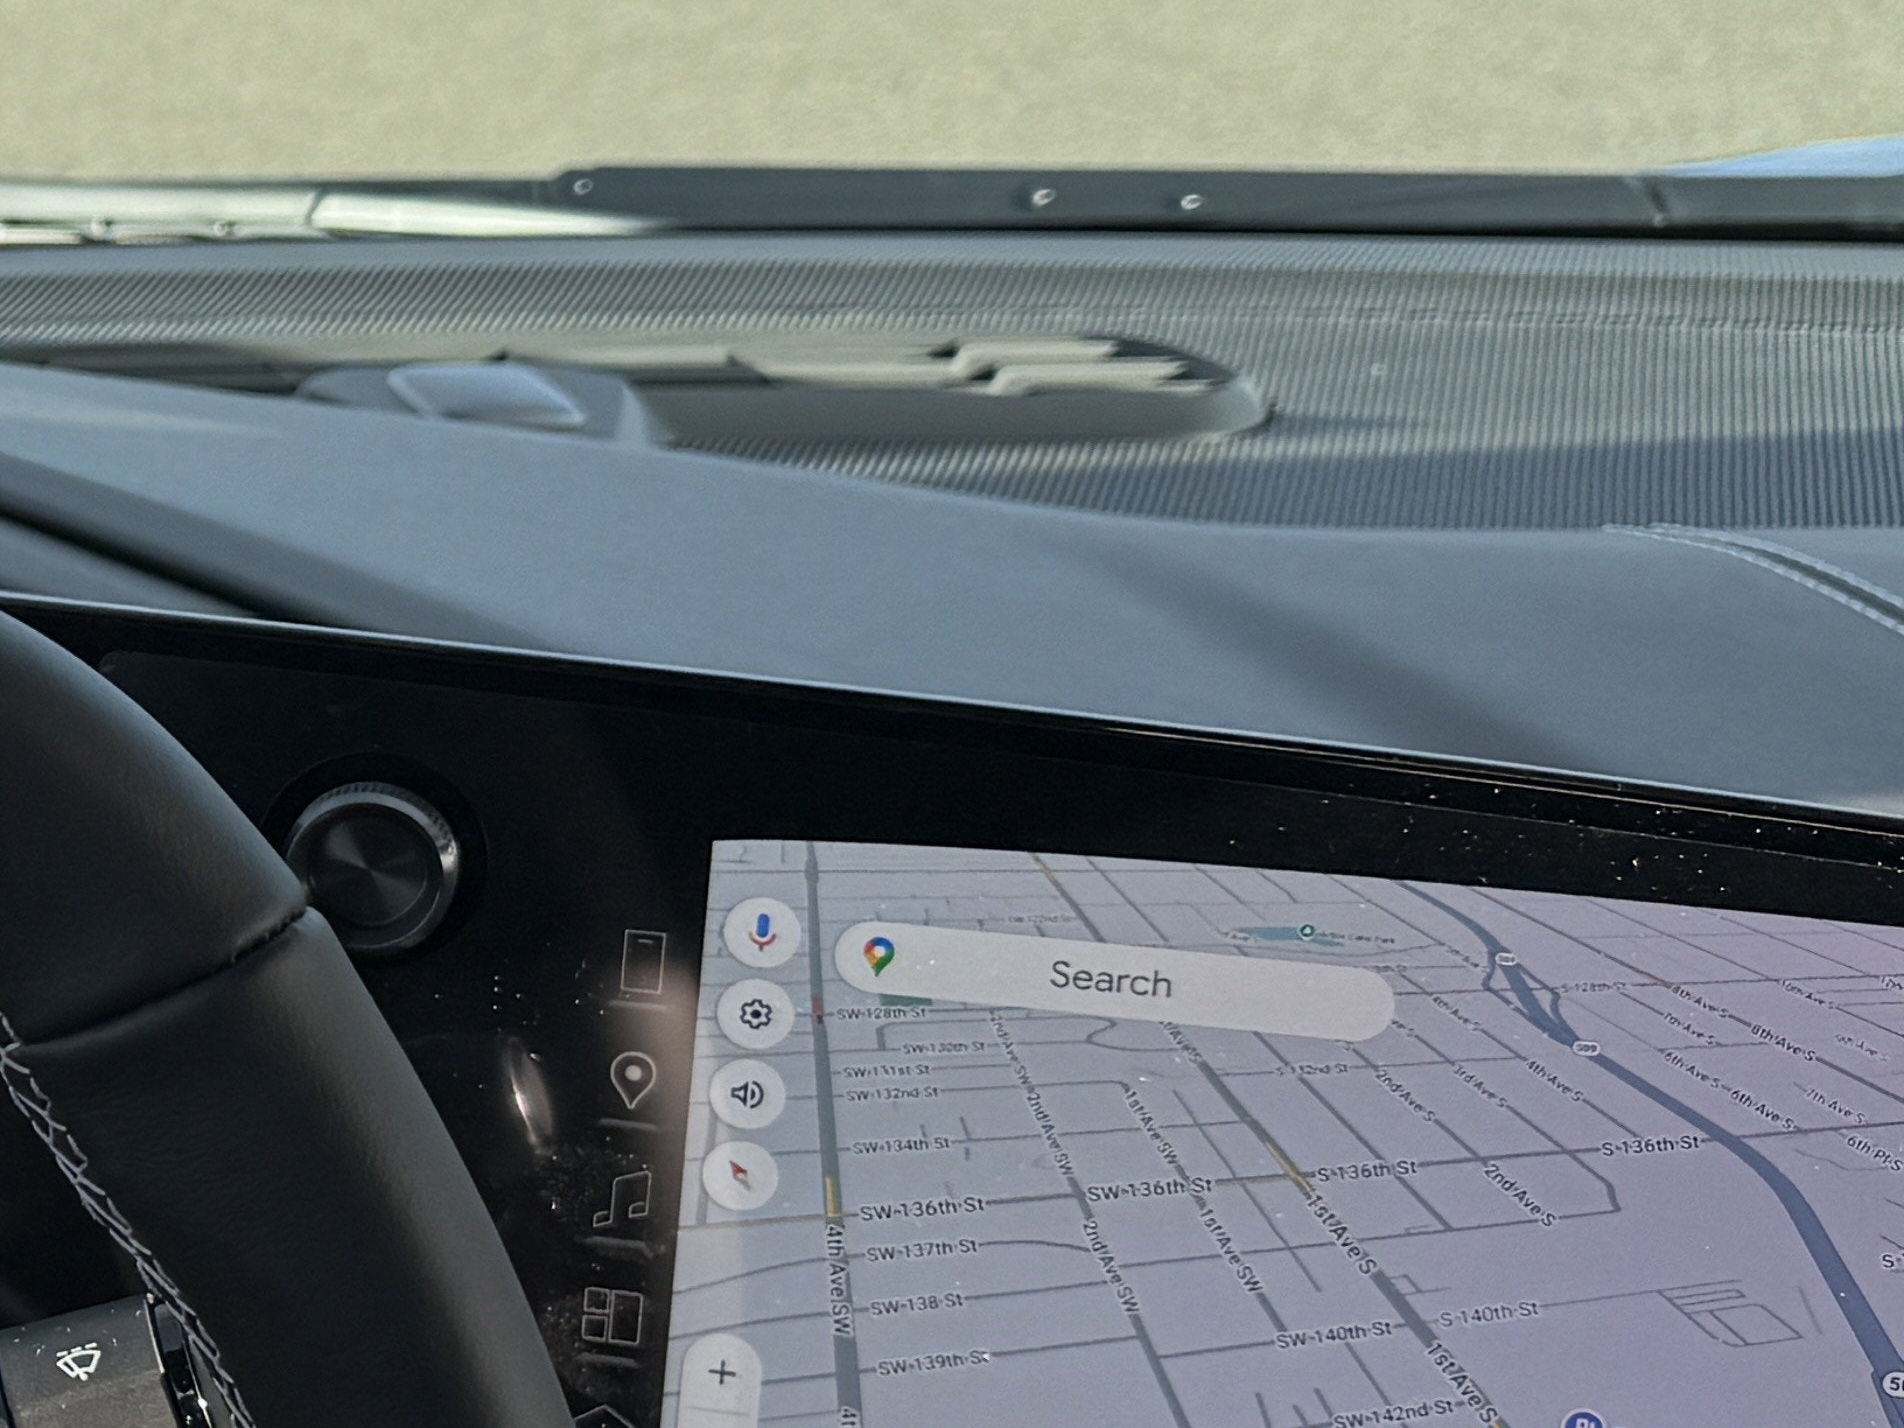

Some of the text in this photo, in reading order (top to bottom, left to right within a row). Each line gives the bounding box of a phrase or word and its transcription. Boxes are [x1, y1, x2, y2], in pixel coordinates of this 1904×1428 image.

[1050, 960, 1172, 998] Search
[1775, 1035, 1802, 1055] Ave
[1804, 1049, 1816, 1061] S
[1548, 1074, 1571, 1093] Ave
[1572, 1091, 1583, 1102] S
[1686, 1064, 1710, 1086] Ave
[1710, 1077, 1721, 1088] S
[1376, 1070, 1435, 1122] 2nd Ave S
[1474, 1081, 1496, 1099] Ave
[1497, 1097, 1507, 1108] S
[1730, 1089, 1795, 1129] 6th Ave S
[1602, 1136, 1700, 1157] S 136th St
[1848, 1136, 1871, 1154] 6th
[1317, 1161, 1416, 1182] S 136th St
[1087, 1178, 1212, 1201] SW 136th St
[1484, 1164, 1556, 1227] 2nd Ave S
[860, 1197, 984, 1221] SW 136th St
[1308, 1194, 1377, 1275] 1st Ave S
[867, 1239, 978, 1262] SW 137th St
[1084, 1222, 1140, 1314] 2nd Ave SW
[1218, 1236, 1241, 1265] Ave
[1237, 1266, 1262, 1292] SW
[827, 1224, 850, 1335] 4th Ave SW
[871, 1293, 963, 1316] SW 138 St
[1441, 1302, 1538, 1327] S 140th St
[1276, 1322, 1392, 1349] SW 140th St
[879, 1361, 907, 1376] SW
[917, 1353, 962, 1371] 139th
[1427, 1343, 1498, 1423] 1st Ave S
[1372, 1404, 1428, 1424] 142nd
[1432, 1401, 1453, 1414] St
